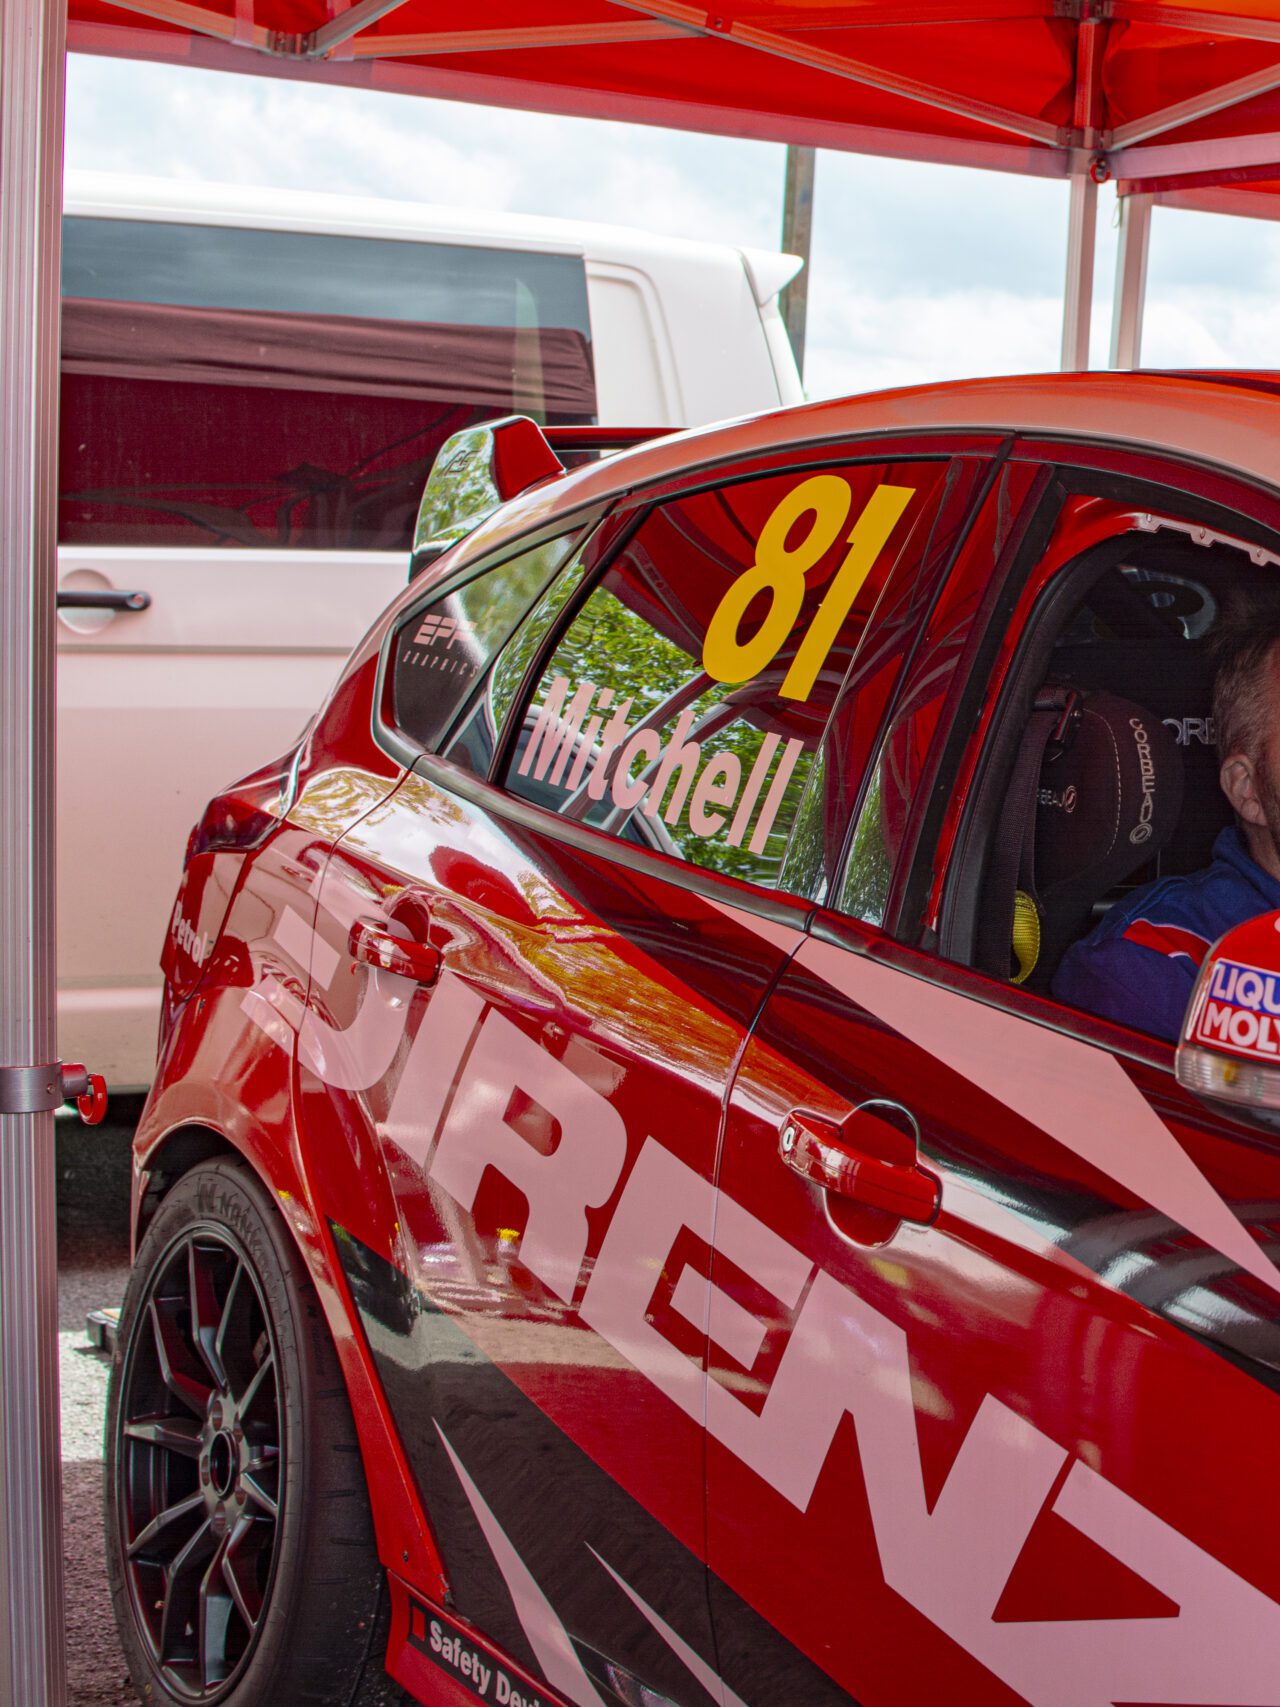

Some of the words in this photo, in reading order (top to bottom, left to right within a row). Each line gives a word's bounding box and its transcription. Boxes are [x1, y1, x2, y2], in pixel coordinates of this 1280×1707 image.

[702, 474, 917, 702] 81
[516, 675, 805, 856] Mitchell
[1128, 717, 1156, 825] CORBEAU
[429, 1619, 491, 1696] Safety
